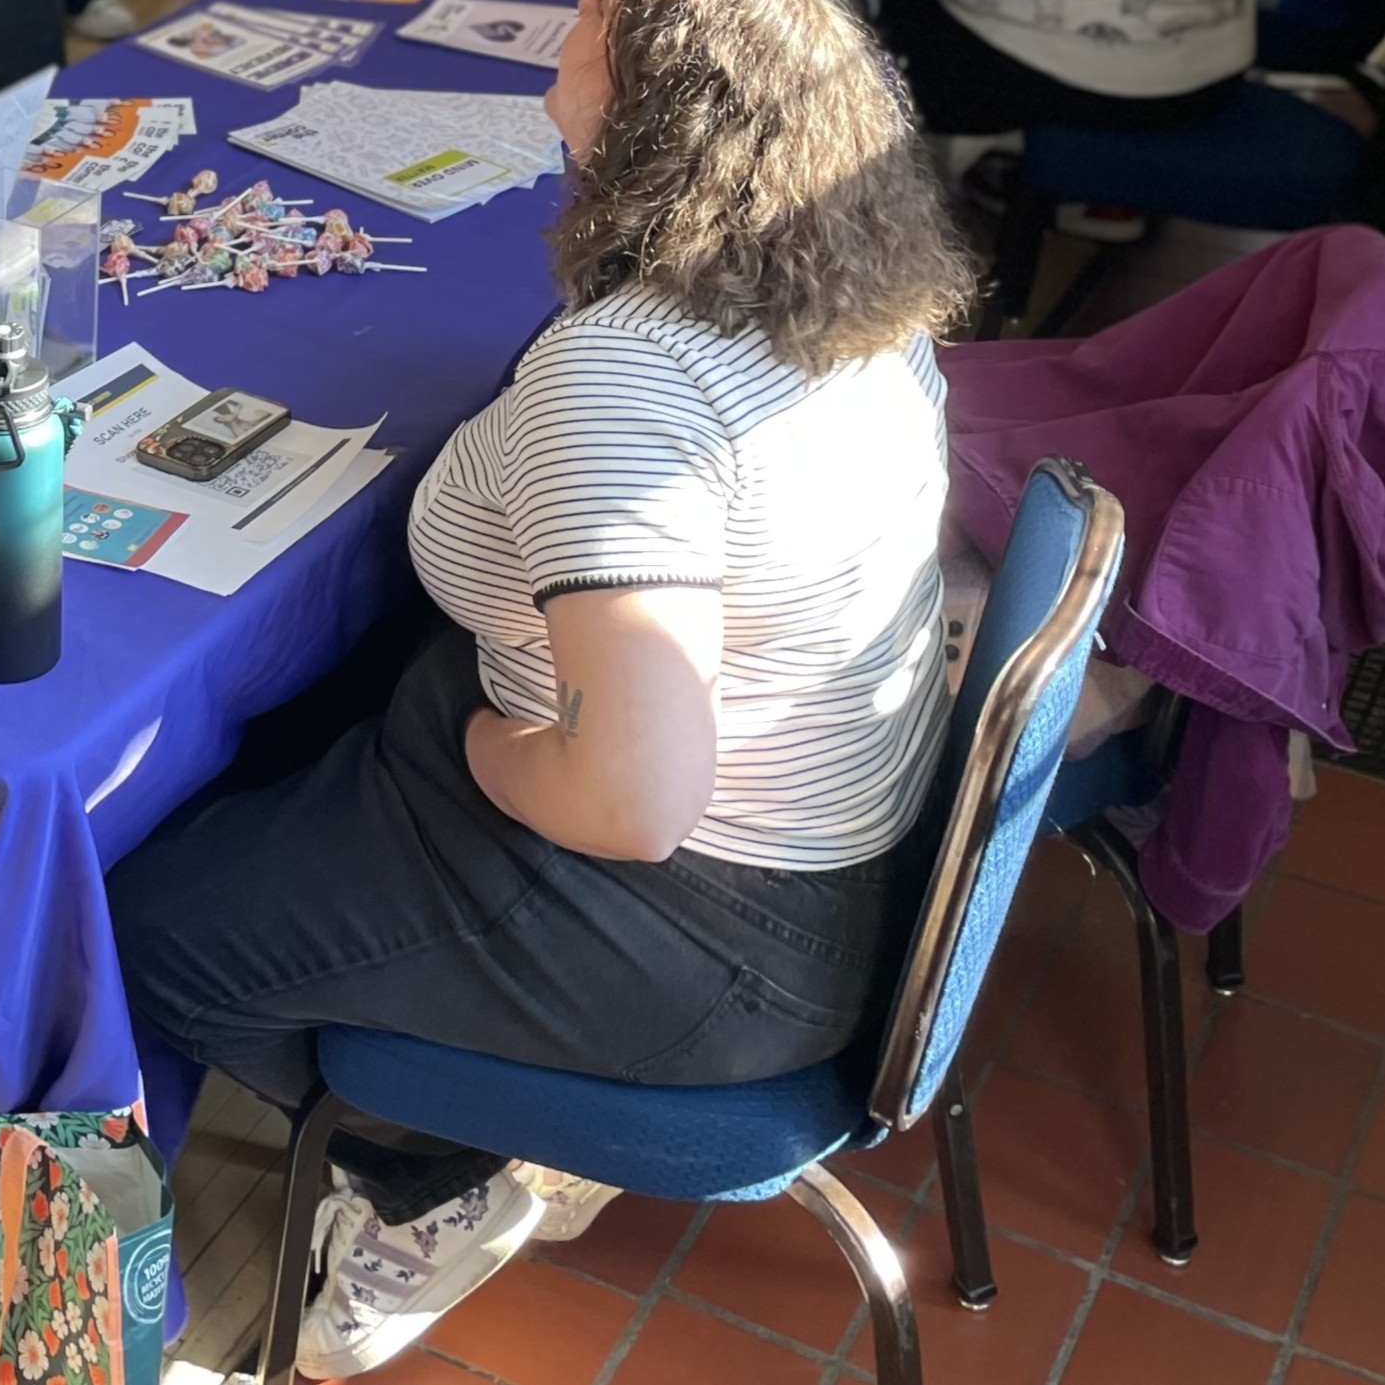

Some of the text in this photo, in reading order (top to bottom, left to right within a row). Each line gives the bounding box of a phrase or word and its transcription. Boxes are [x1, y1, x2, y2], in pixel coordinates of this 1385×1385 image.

[412, 158, 480, 189] MIND OVER
[93, 422, 125, 446] SCAN
[120, 407, 152, 429] HERE
